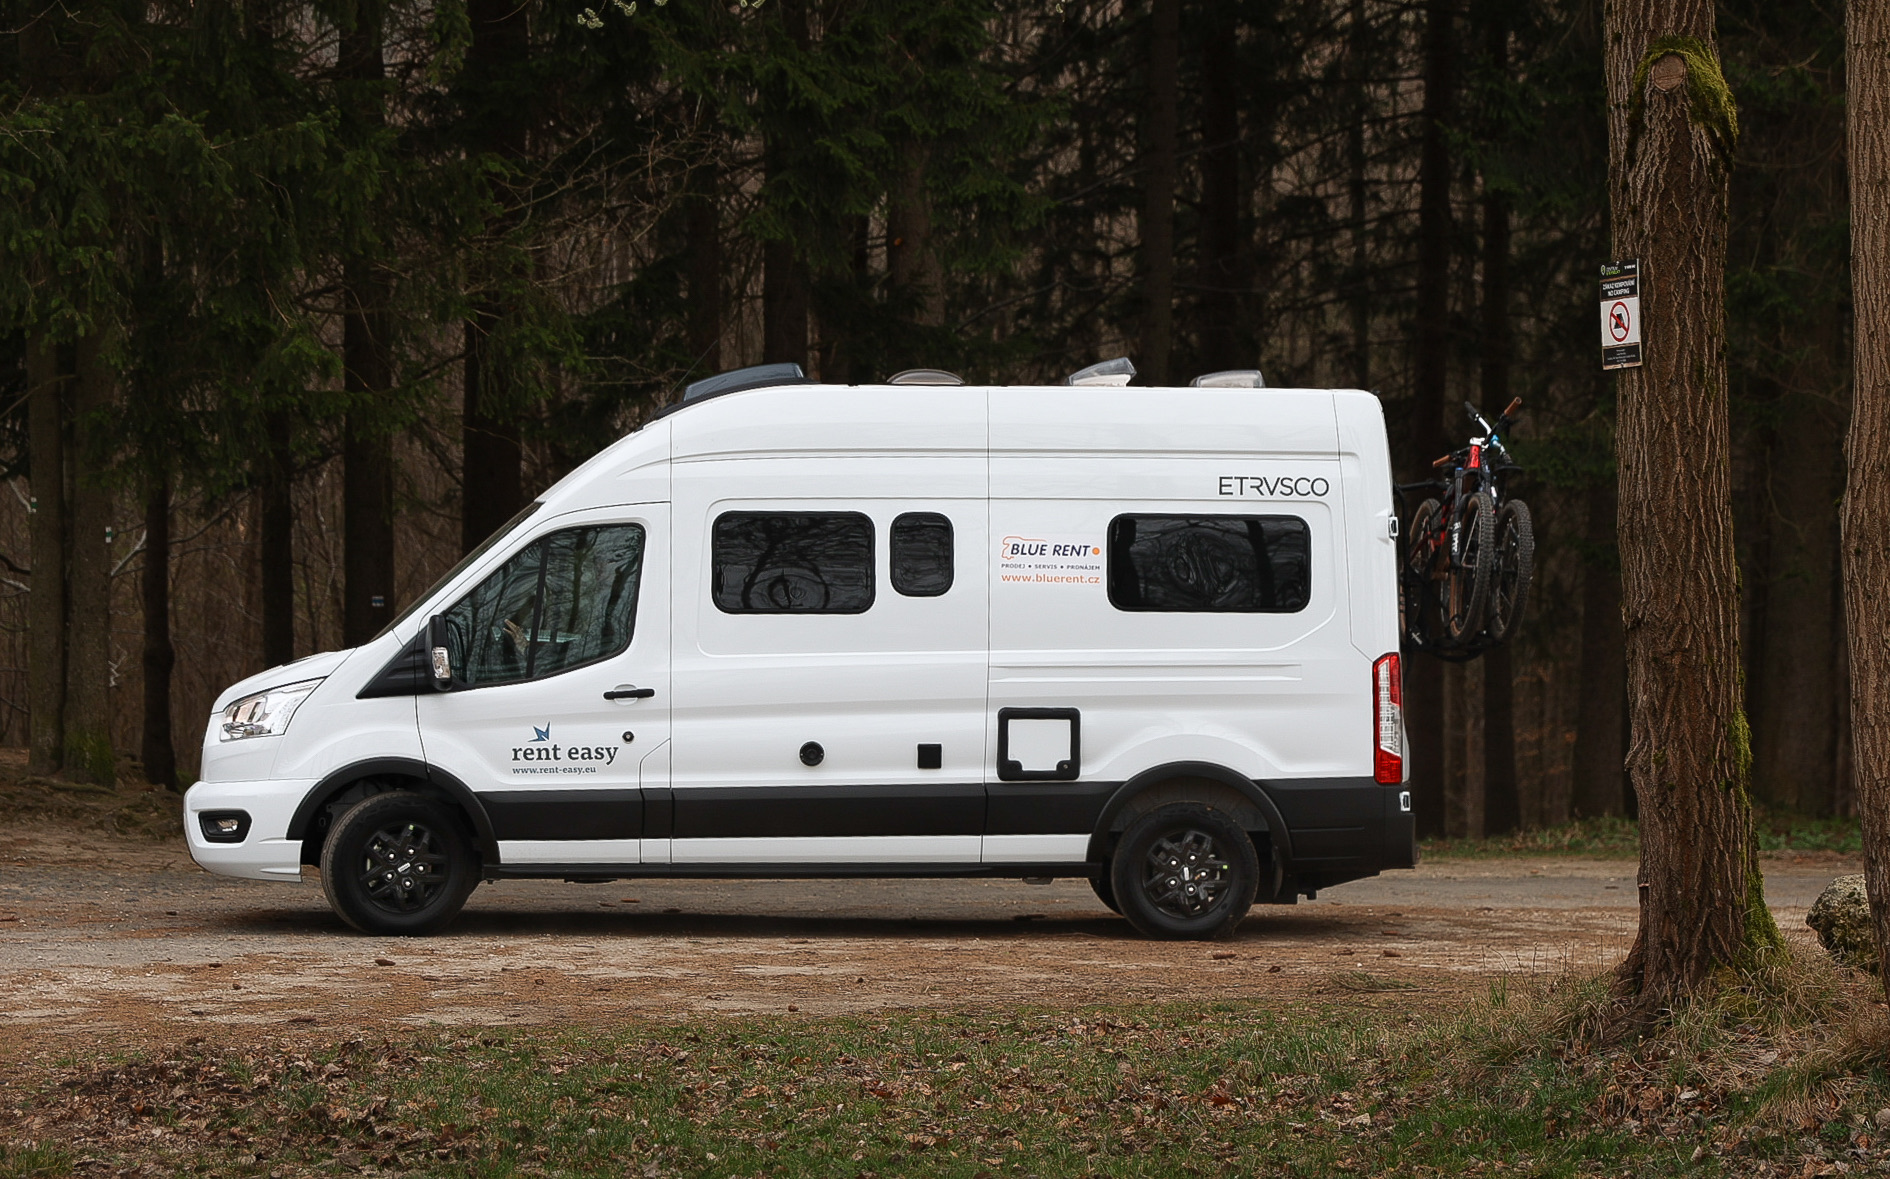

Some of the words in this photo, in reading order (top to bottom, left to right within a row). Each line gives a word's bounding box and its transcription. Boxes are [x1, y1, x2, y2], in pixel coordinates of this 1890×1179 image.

[1613, 288, 1630, 296] CAMPING
[1010, 543, 1048, 556] BLUE
[1052, 544, 1091, 557] RENT
[1001, 573, 1100, 584] www.bluerent.cz
[511, 744, 561, 761] rent
[567, 746, 619, 766] easy
[512, 766, 597, 775] www.rent-easy.eu
